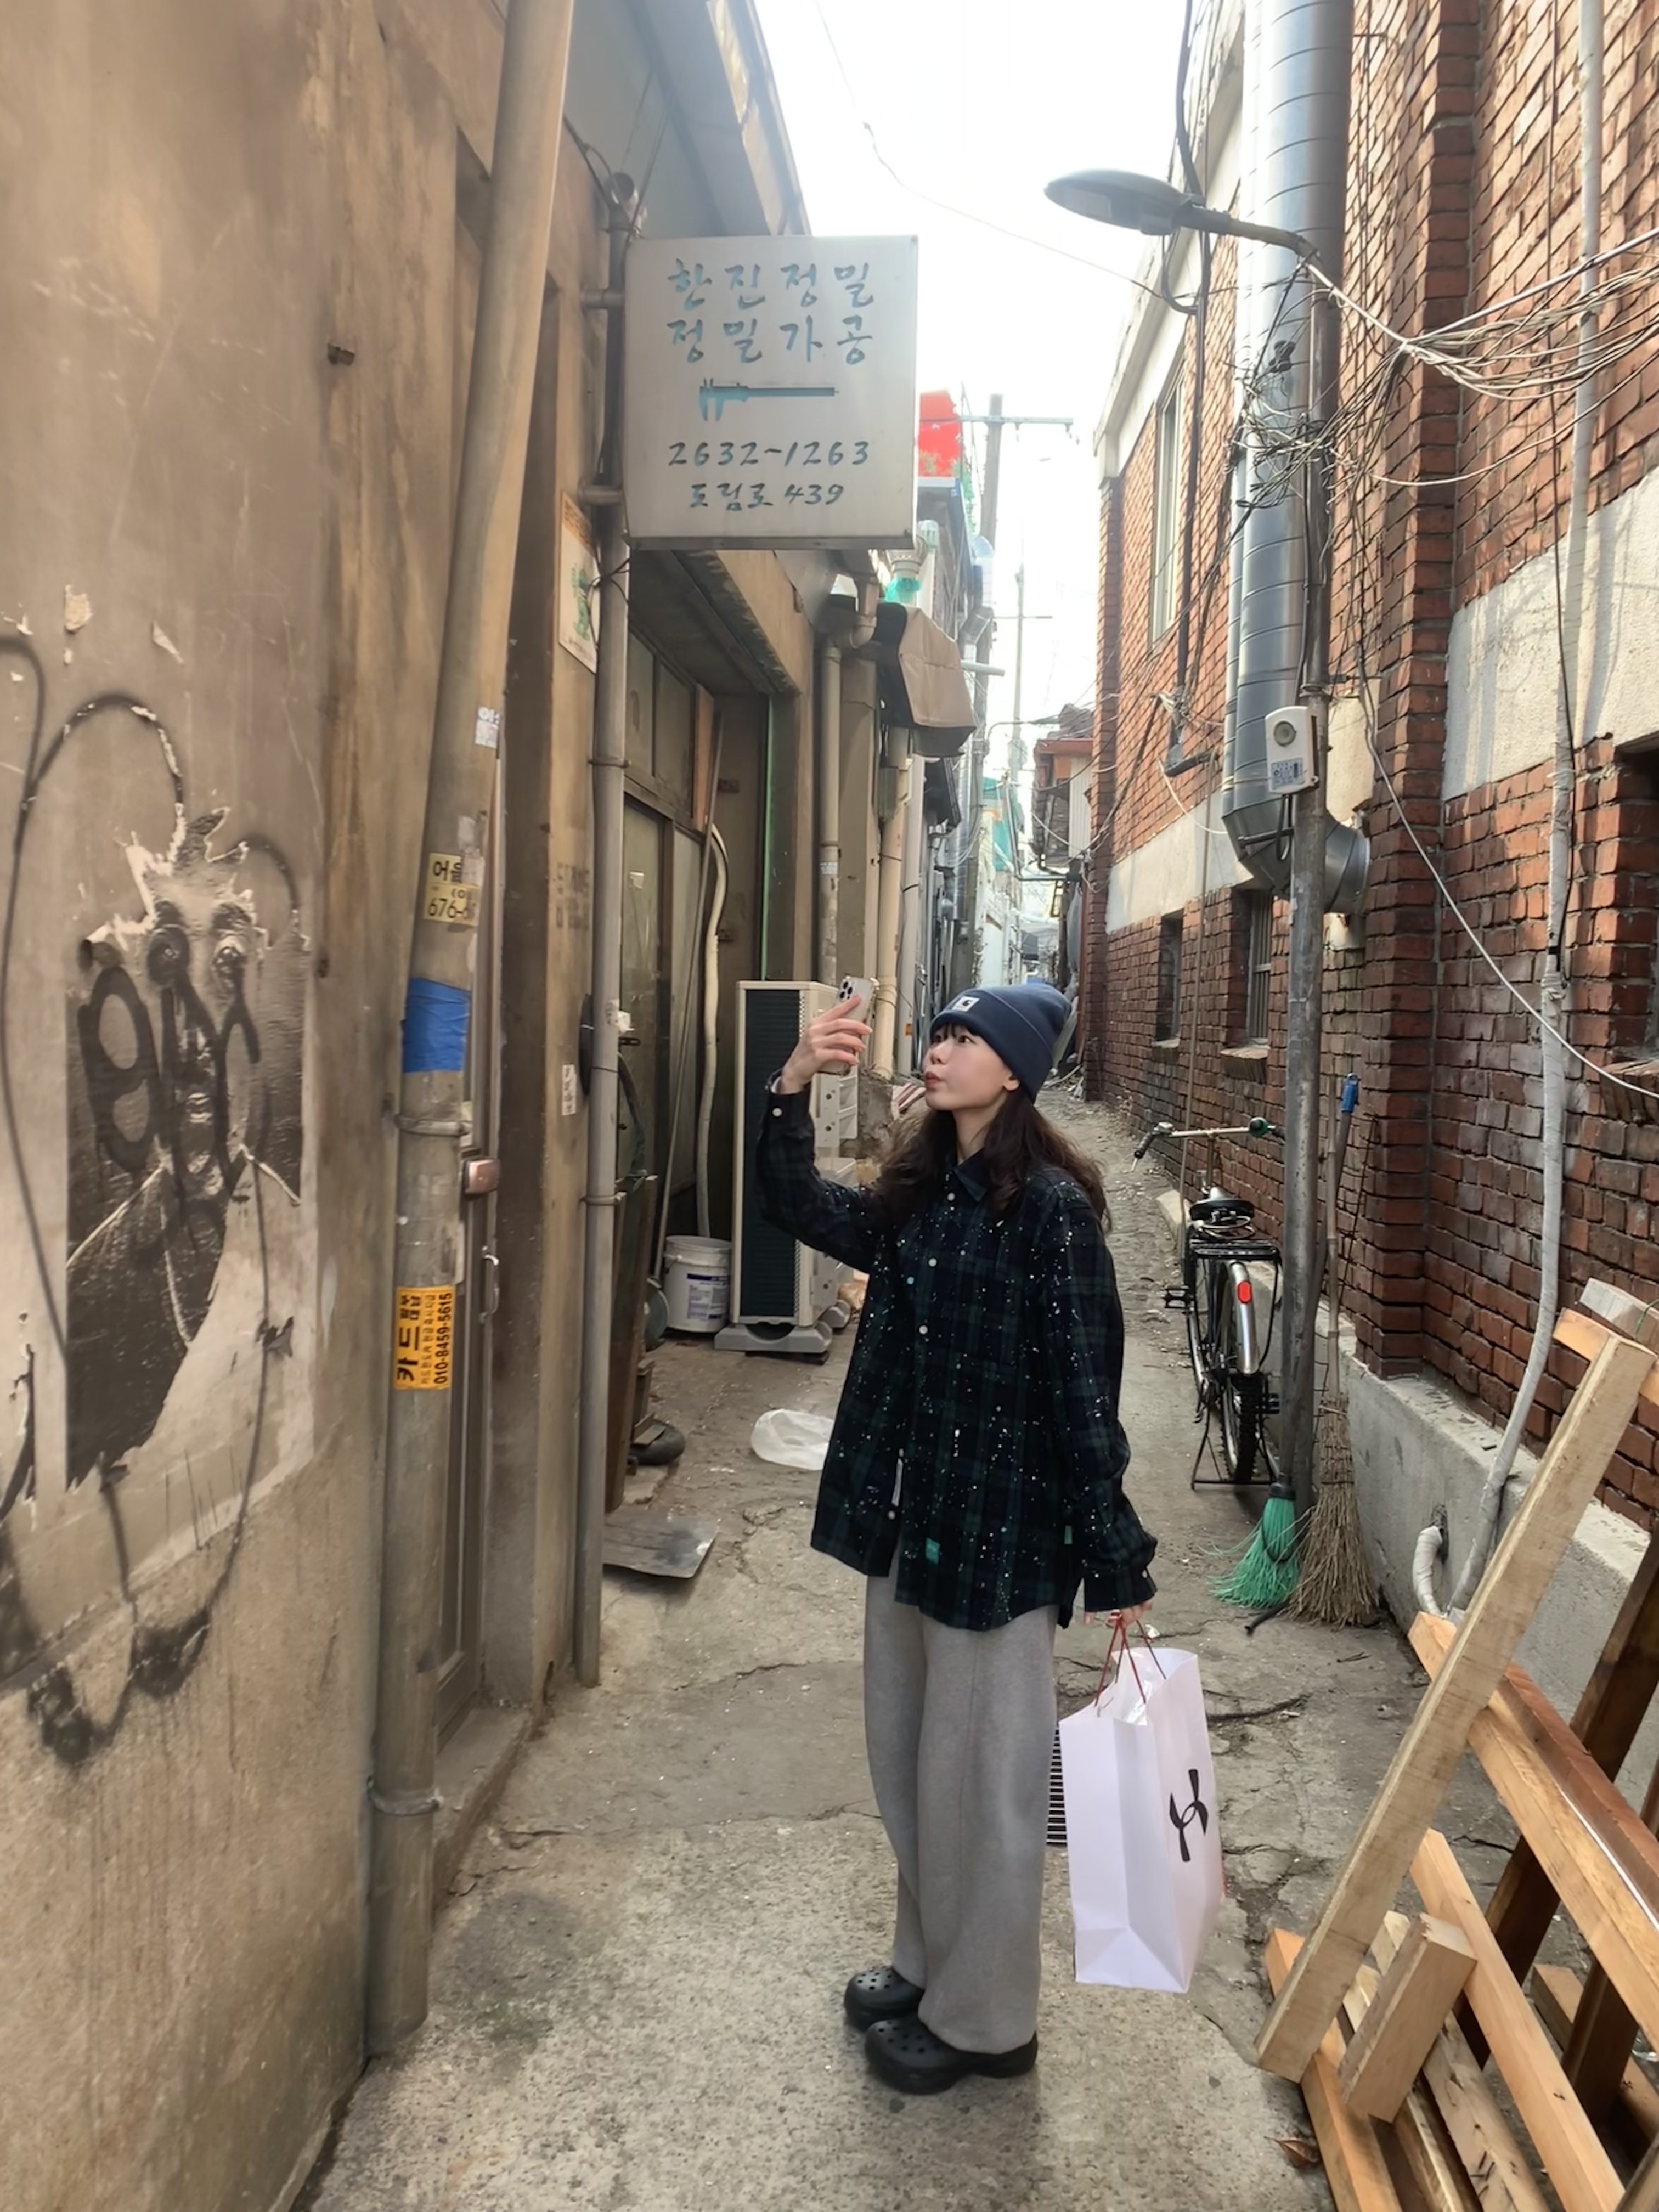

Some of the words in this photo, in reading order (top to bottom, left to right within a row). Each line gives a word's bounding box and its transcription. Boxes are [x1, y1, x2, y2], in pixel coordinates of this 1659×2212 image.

[667, 258, 874, 311] 한진정밀
[667, 315, 873, 365] 정밀가공
[668, 441, 870, 467] 2632-1263
[784, 484, 844, 505] 439
[397, 1326, 420, 1381] 카드
[433, 1293, 452, 1384] 010-8459-5615
